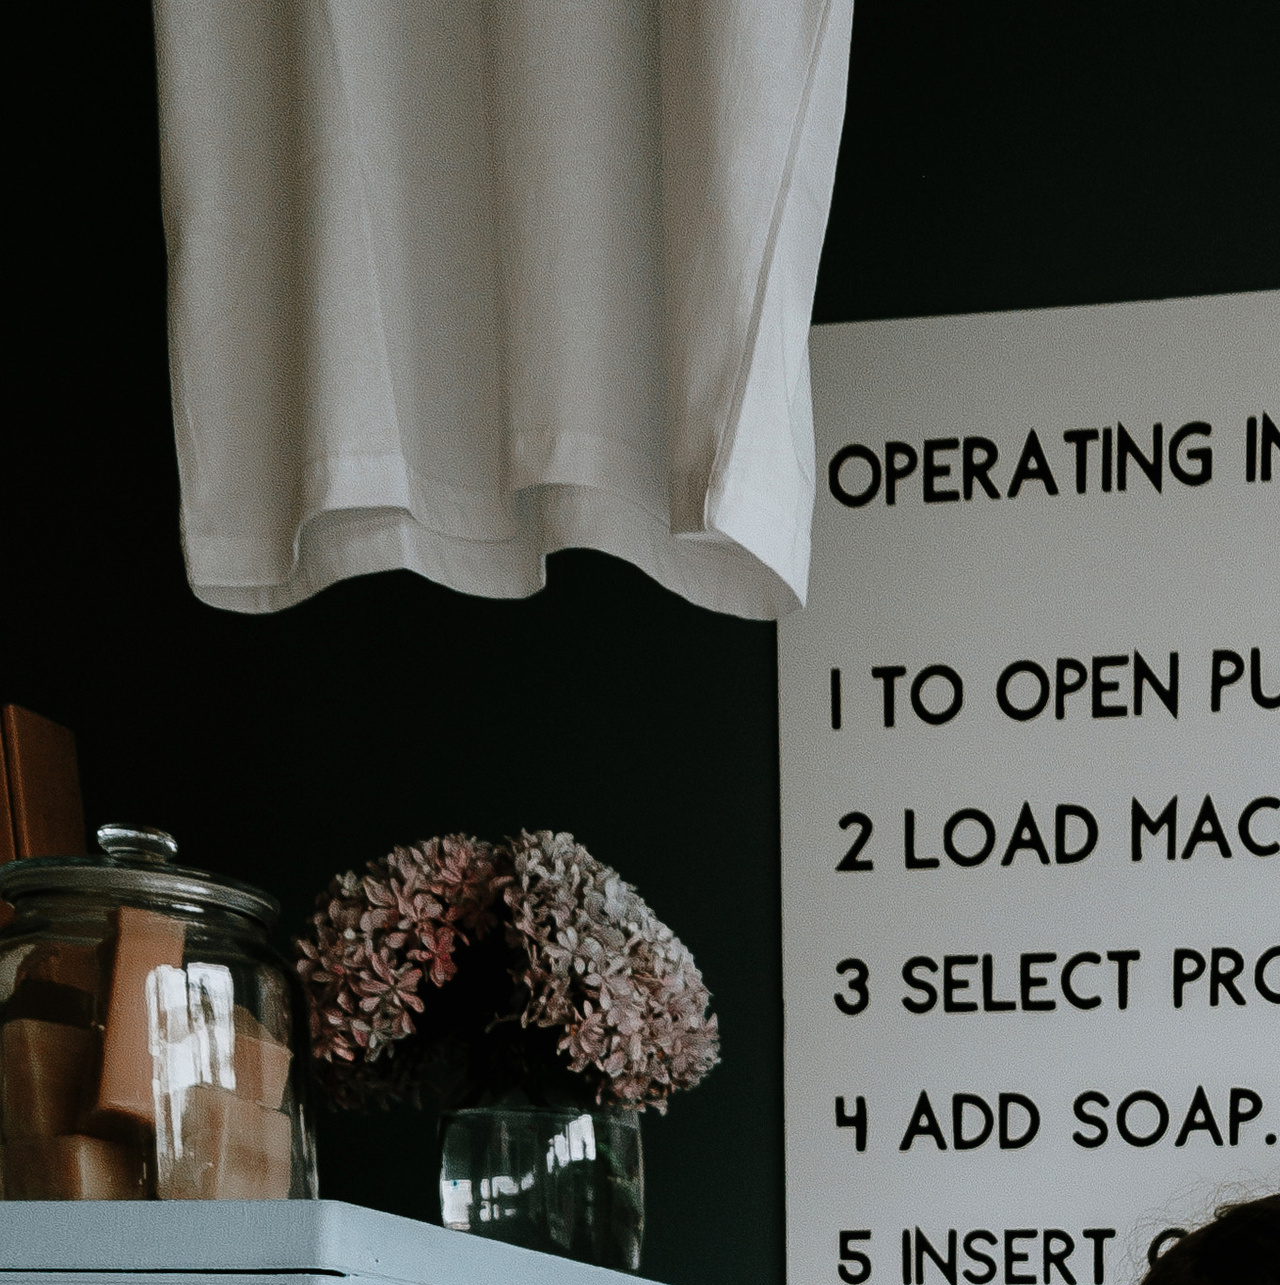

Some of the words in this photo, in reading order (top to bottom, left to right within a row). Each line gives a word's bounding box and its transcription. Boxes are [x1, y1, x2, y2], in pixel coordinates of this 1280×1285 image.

[827, 419, 1214, 510] OPERATING
[870, 663, 965, 730] TO
[994, 649, 1181, 724] OPEN
[833, 810, 875, 874] 2
[903, 800, 1100, 871] LOAD
[832, 956, 871, 1017] 3
[900, 948, 1142, 1016] SELECT
[833, 1094, 869, 1153] 4
[898, 1088, 1042, 1152] ADD
[1071, 1084, 1278, 1150] SOAP.
